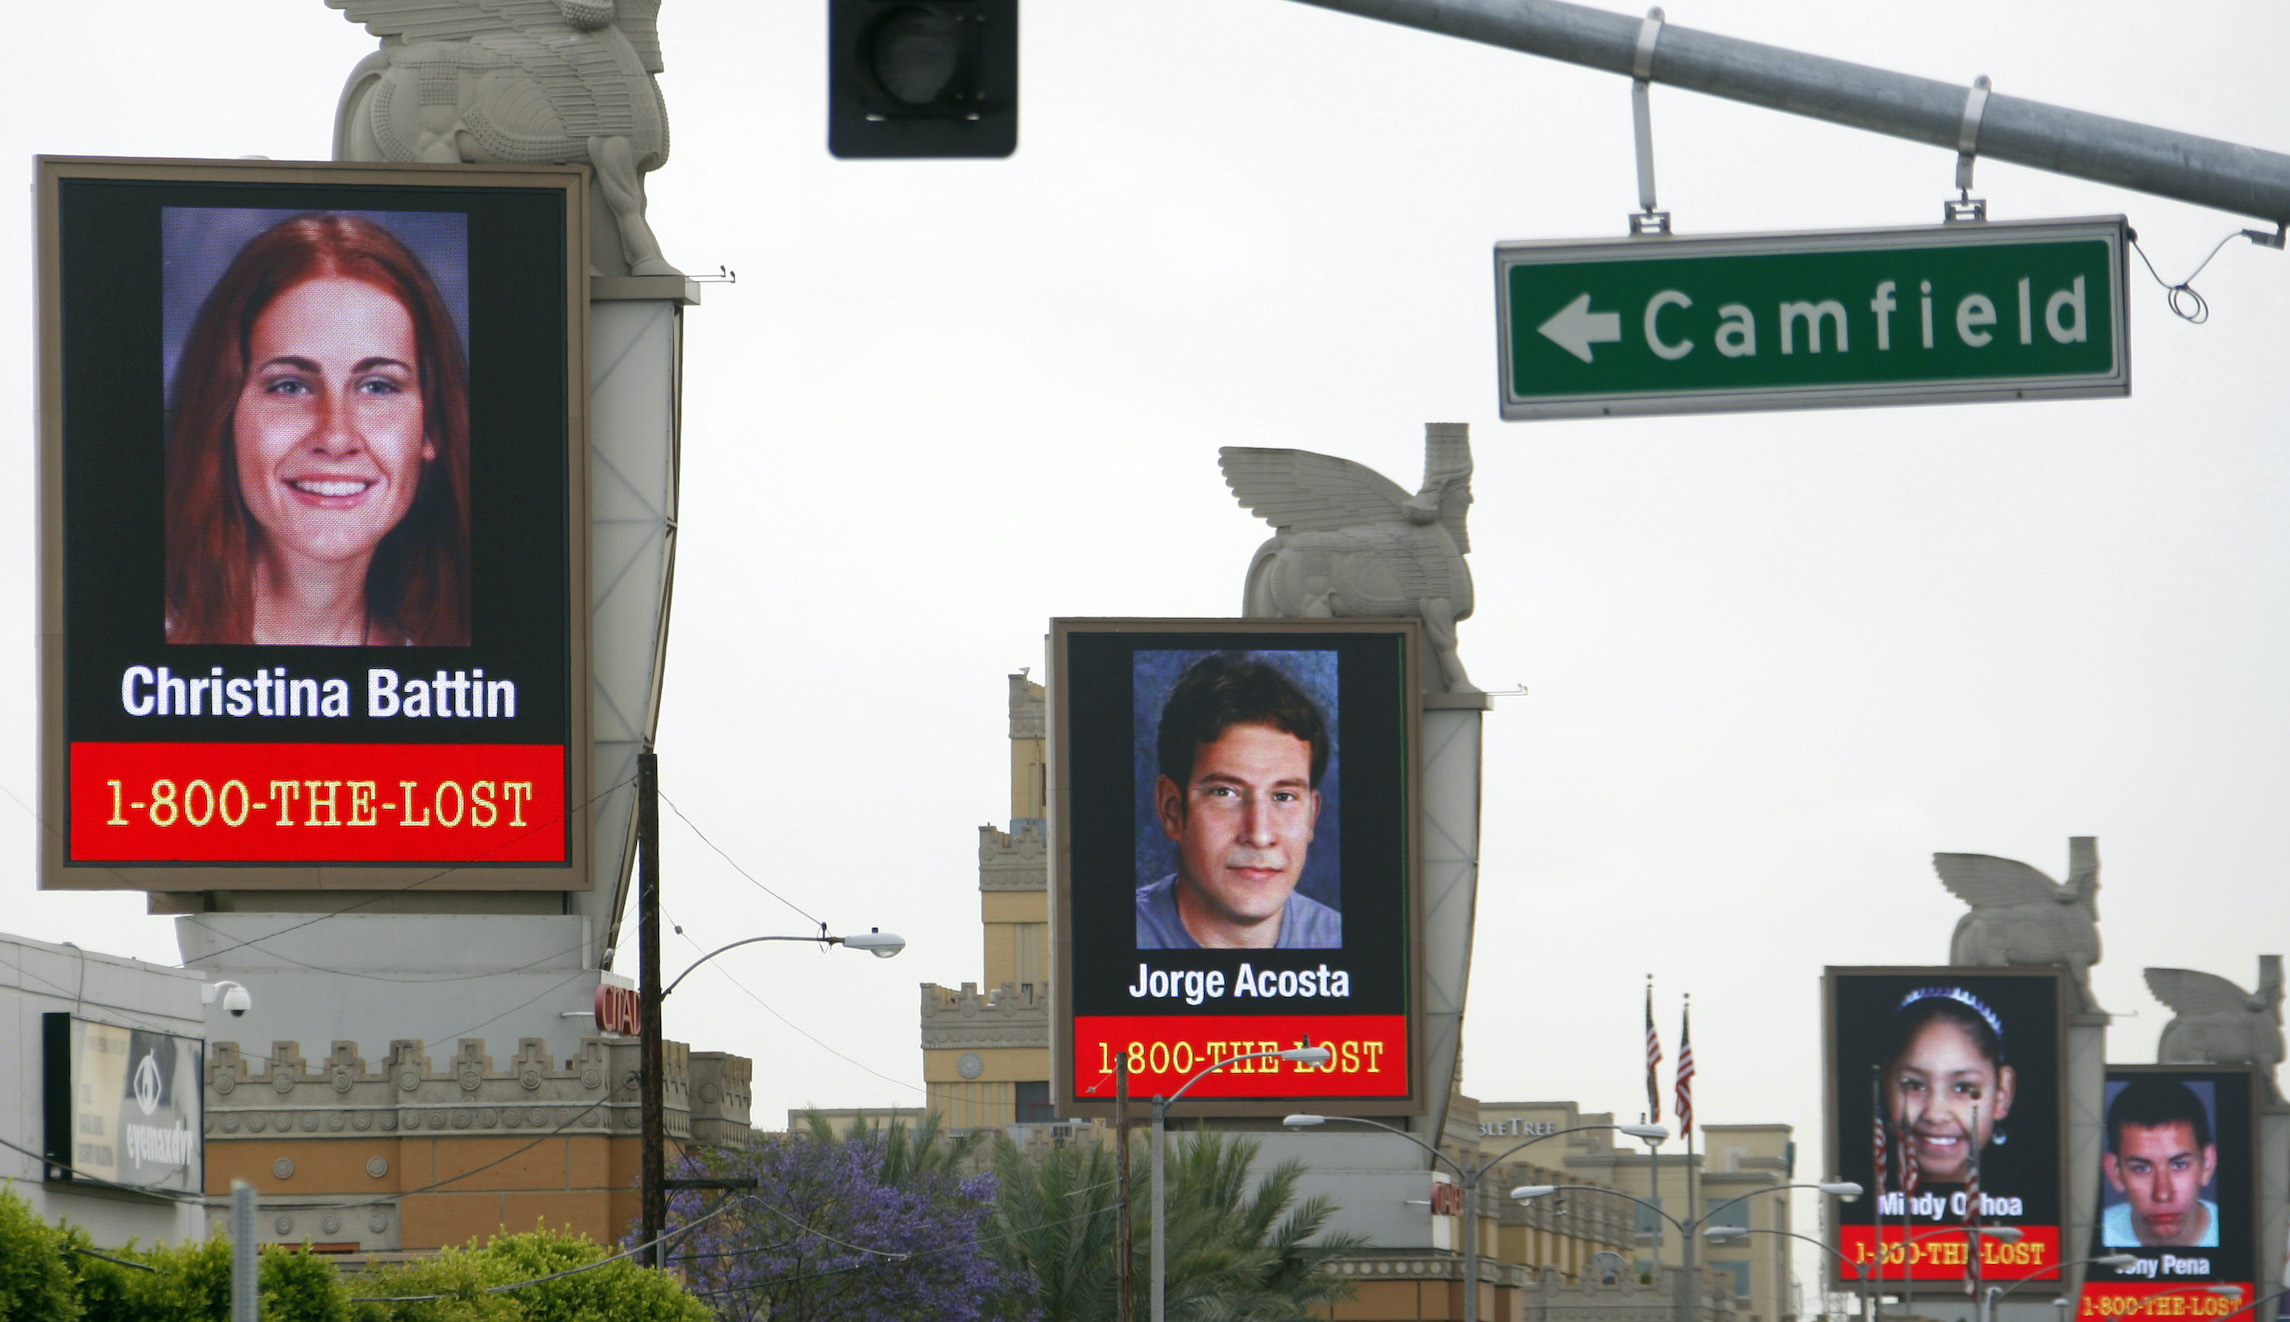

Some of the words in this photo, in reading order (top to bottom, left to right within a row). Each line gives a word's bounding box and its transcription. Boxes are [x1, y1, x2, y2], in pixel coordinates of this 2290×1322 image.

[1643, 274, 2088, 361] Camfield
[121, 664, 349, 718] Christina
[366, 667, 517, 718] Battin
[107, 779, 533, 828] 1-800-THE-LOST
[1129, 963, 1226, 1006] Jorge
[1234, 963, 1350, 998] Acosta
[1098, 1041, 1384, 1075] 1800-THELOST
[1951, 1191, 2024, 1216] Ohoa
[2115, 1256, 2159, 1279] ny
[2161, 1253, 2211, 1275] Pena
